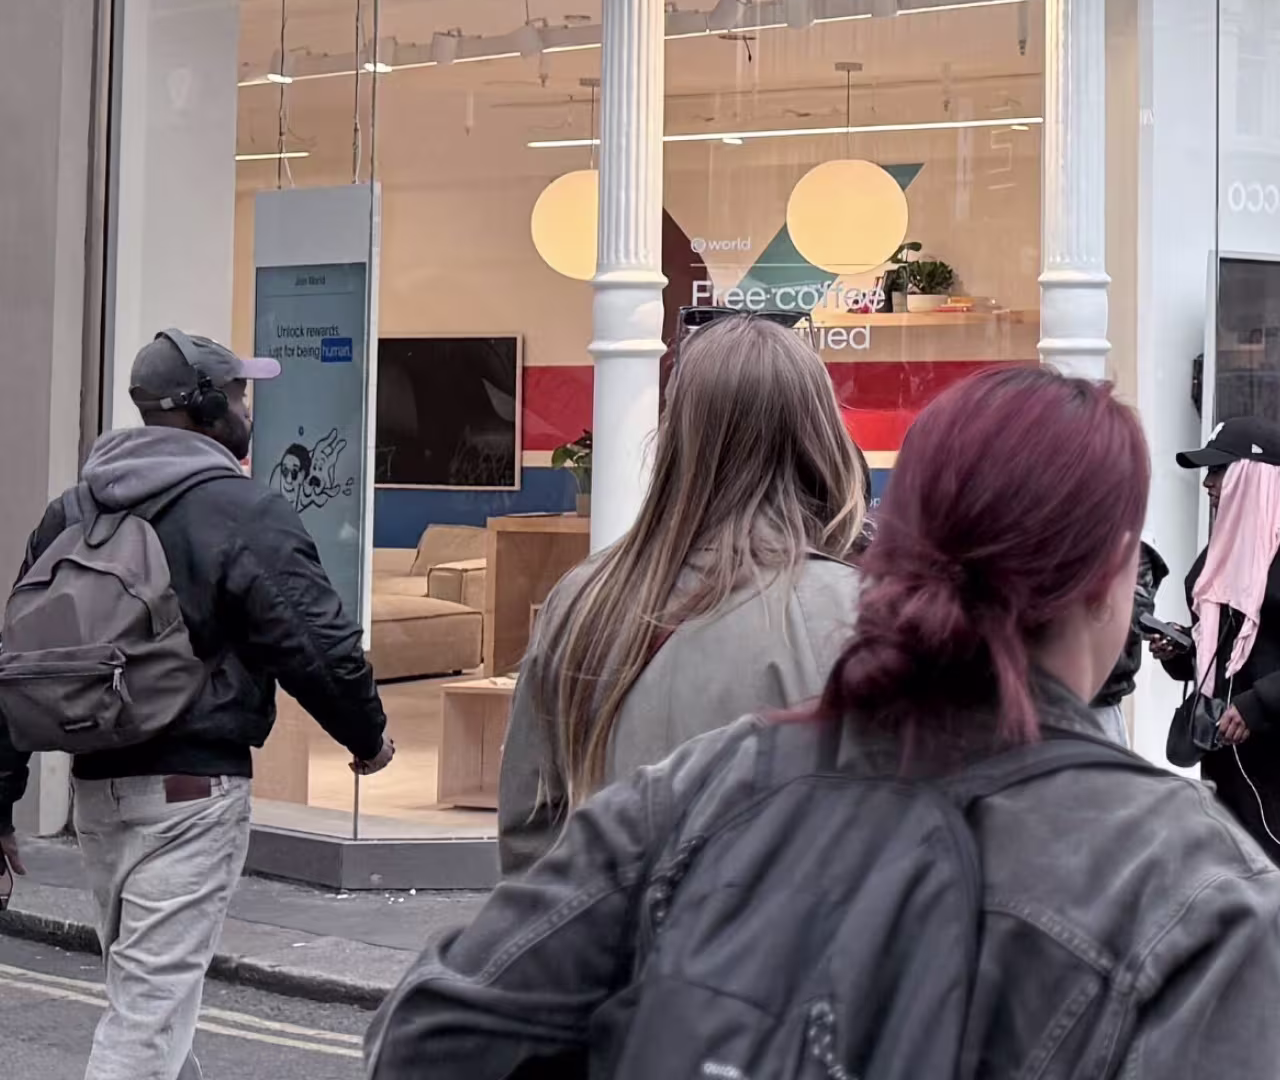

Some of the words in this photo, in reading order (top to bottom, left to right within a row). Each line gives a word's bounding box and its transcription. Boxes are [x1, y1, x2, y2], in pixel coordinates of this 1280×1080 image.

[708, 237, 750, 250] world
[692, 281, 765, 309] Free
[775, 281, 886, 310] coffee
